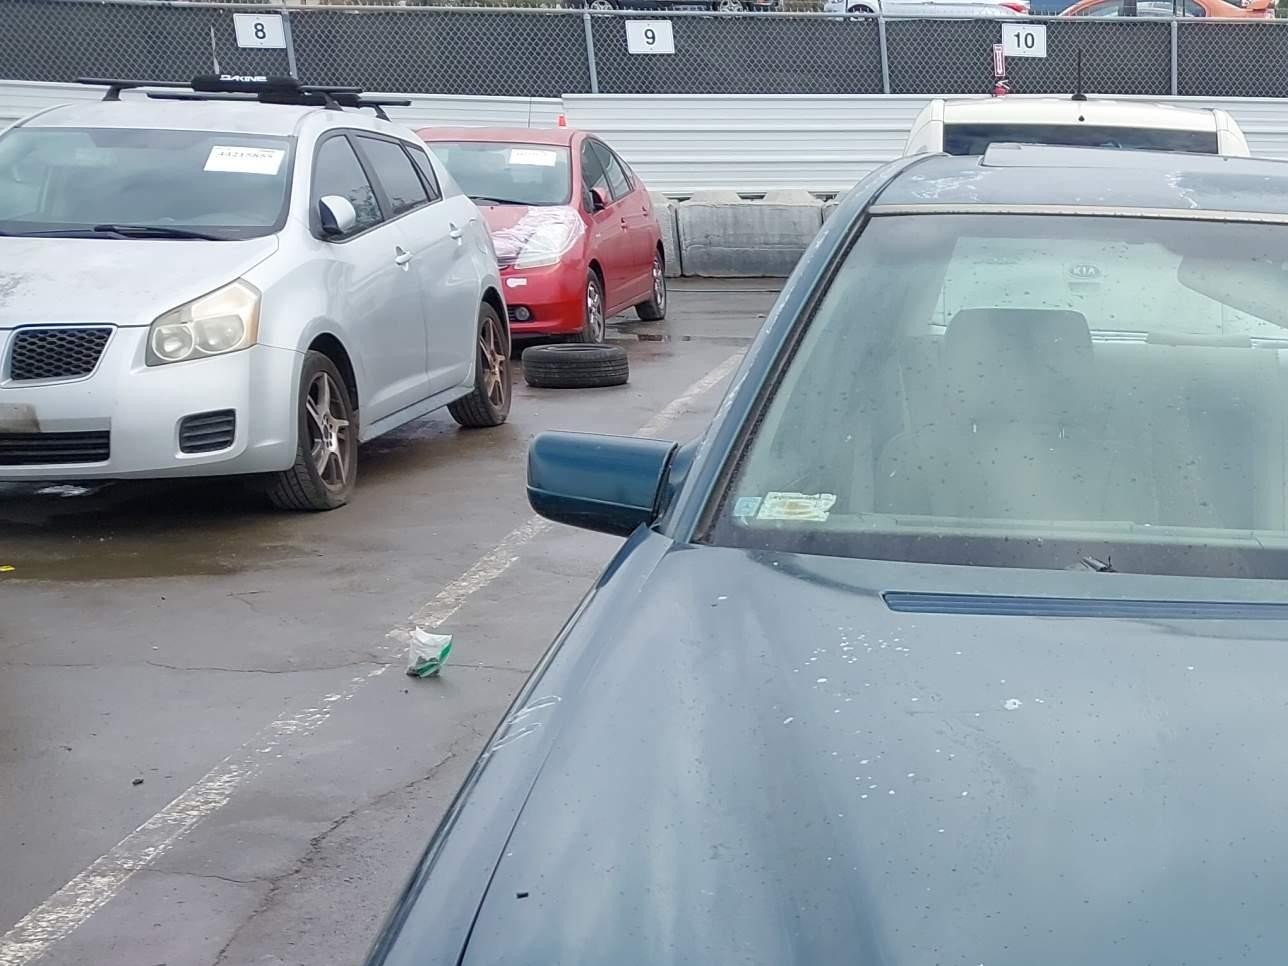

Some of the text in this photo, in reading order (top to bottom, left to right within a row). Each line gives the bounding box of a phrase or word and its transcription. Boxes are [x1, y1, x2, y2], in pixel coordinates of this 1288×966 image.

[254, 22, 266, 40] 8
[644, 28, 656, 46] 9
[1013, 31, 1035, 49] 10
[219, 74, 268, 82] DAKINE
